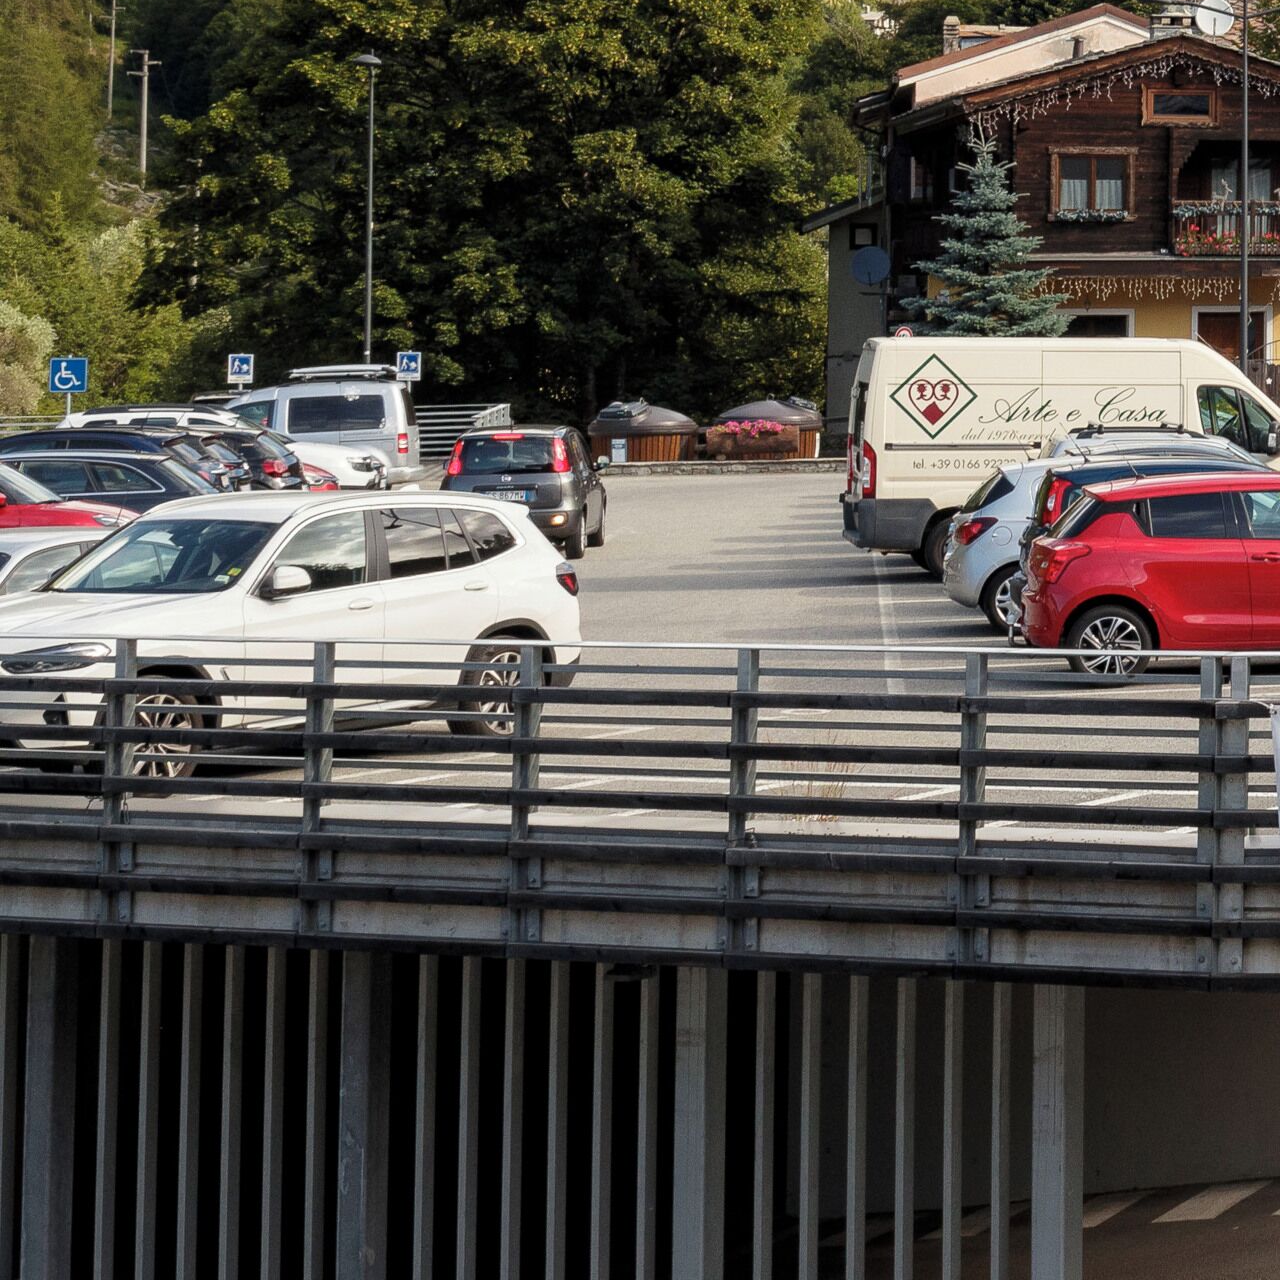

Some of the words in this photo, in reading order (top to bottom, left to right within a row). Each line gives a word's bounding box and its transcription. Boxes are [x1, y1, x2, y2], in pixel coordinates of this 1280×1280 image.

[978, 387, 1059, 424] Arte
[1066, 407, 1082, 422] e
[1094, 386, 1168, 424] Casa
[961, 427, 985, 440] dal
[913, 458, 927, 469] tel.
[930, 459, 951, 469] +39
[953, 458, 981, 469] 0166
